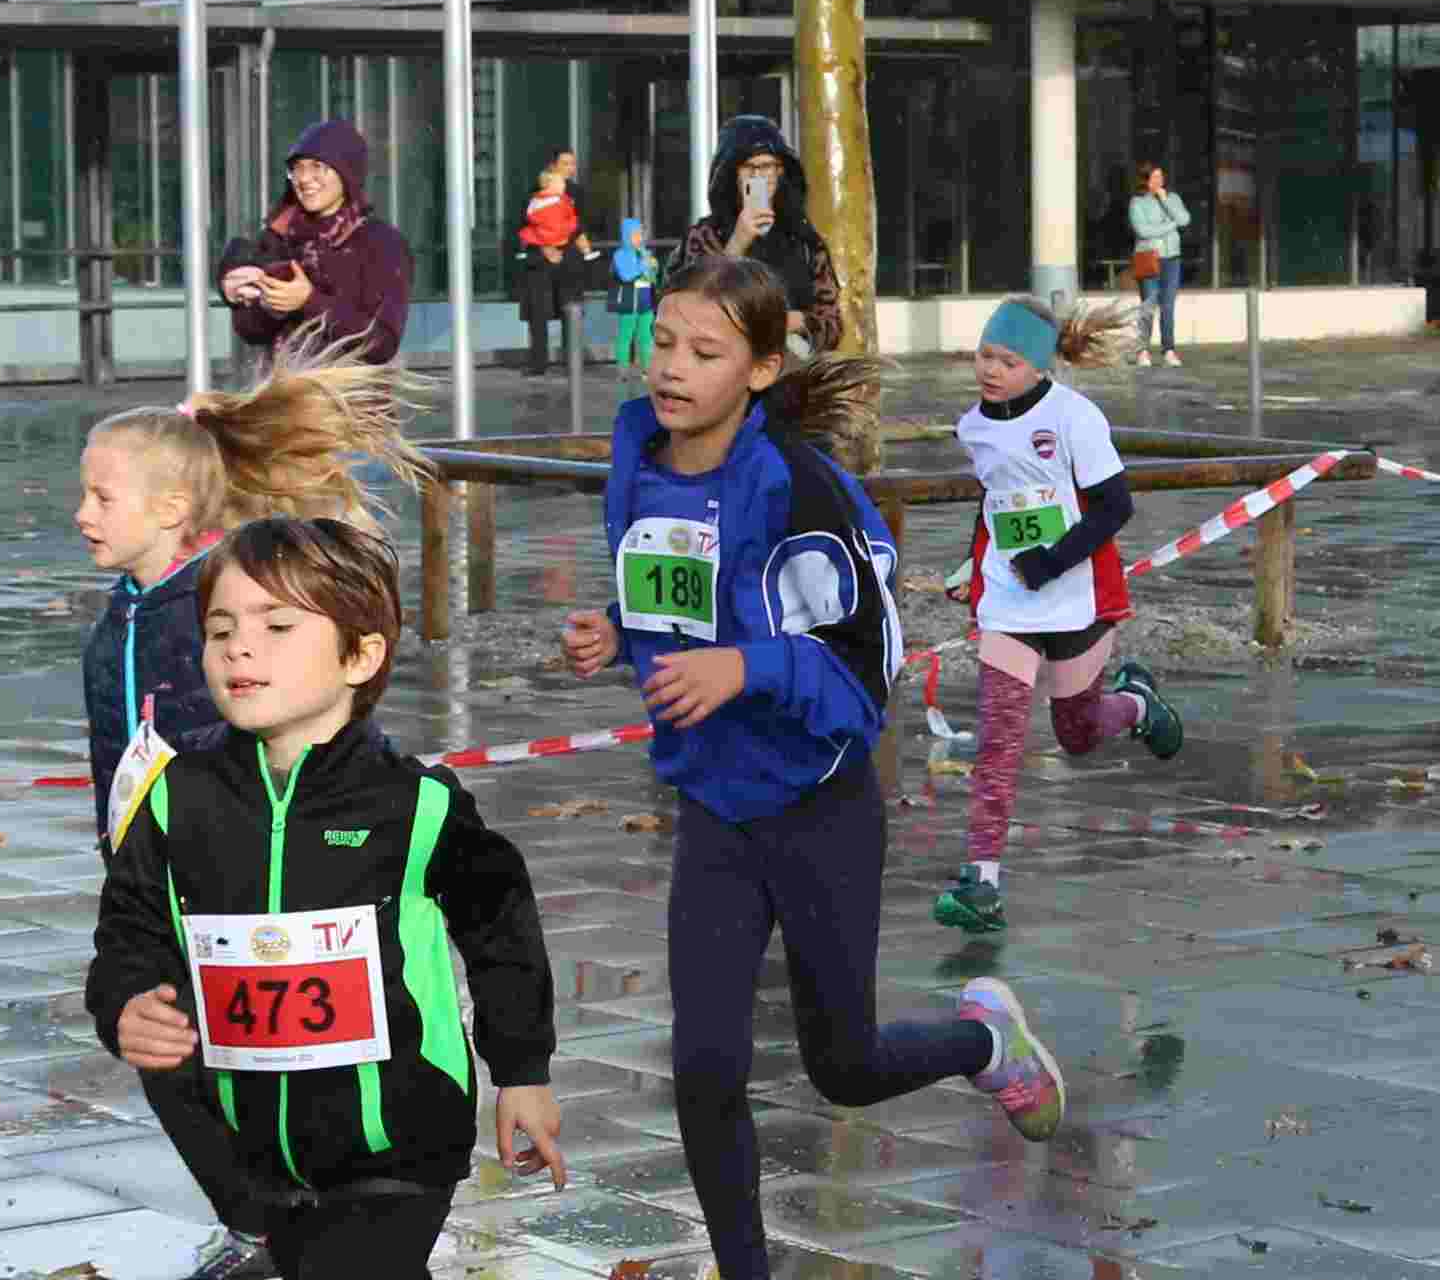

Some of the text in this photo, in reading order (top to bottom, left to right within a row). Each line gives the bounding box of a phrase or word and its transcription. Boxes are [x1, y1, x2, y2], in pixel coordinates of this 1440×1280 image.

[1009, 515, 1042, 542] 35
[646, 562, 703, 609] 189
[226, 976, 336, 1035] 473
